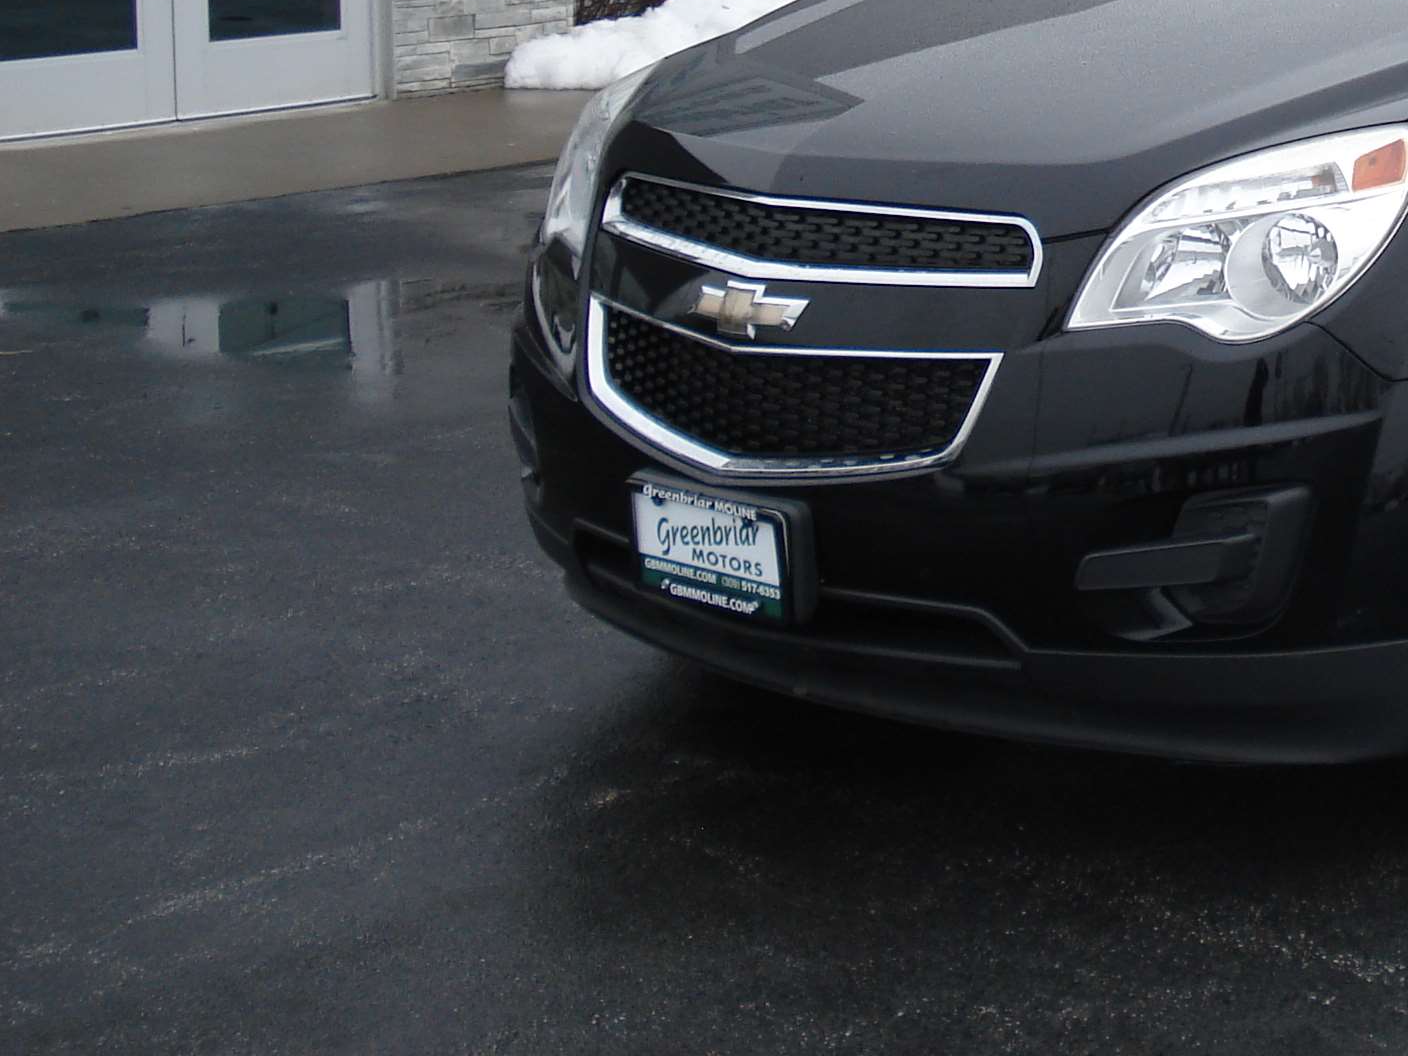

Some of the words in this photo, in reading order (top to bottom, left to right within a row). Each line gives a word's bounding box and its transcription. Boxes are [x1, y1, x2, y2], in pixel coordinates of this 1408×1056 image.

[714, 500, 757, 521] MOLINE
[657, 516, 759, 556] Greenbriar
[692, 548, 763, 577] MOTORS
[644, 558, 717, 584] GBMMOLINE.COM
[741, 580, 781, 600] 517-6353
[670, 583, 753, 614] GBMMOLINE.COM
